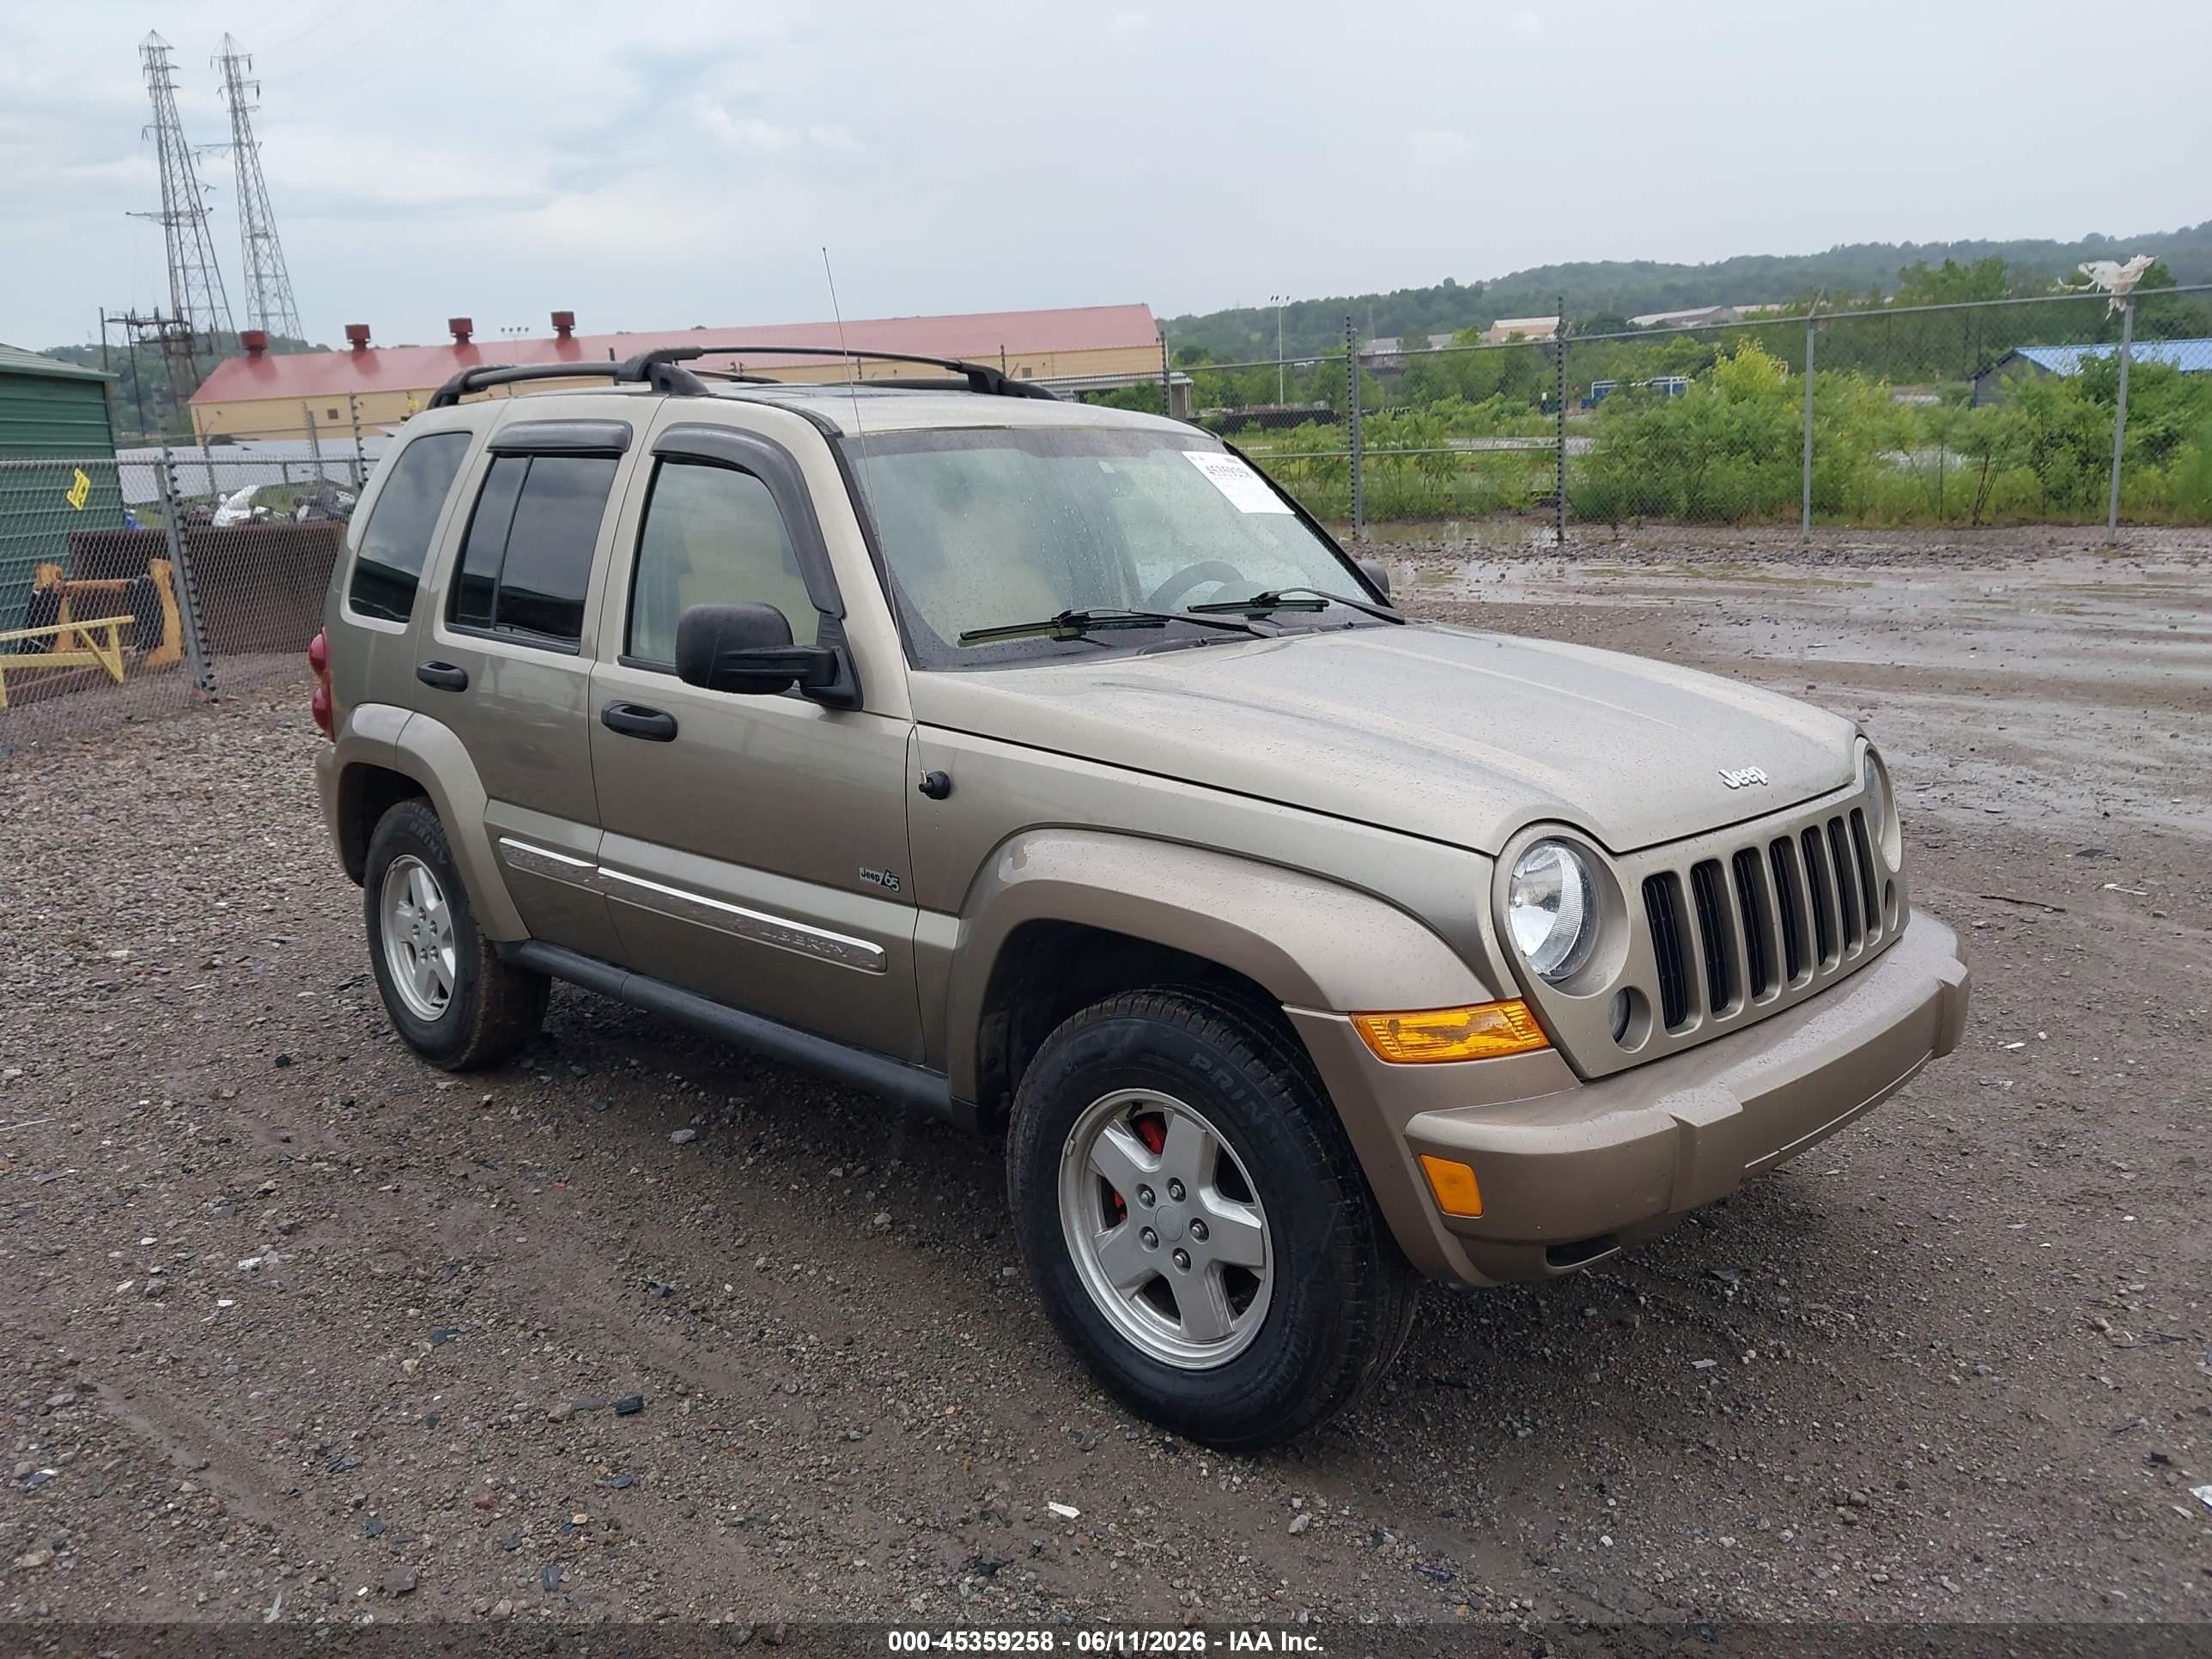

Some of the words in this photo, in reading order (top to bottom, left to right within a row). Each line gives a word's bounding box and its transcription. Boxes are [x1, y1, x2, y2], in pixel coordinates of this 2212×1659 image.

[1718, 766, 1768, 789] Jeep
[860, 867, 880, 883] Jeep
[883, 869, 900, 893] 65
